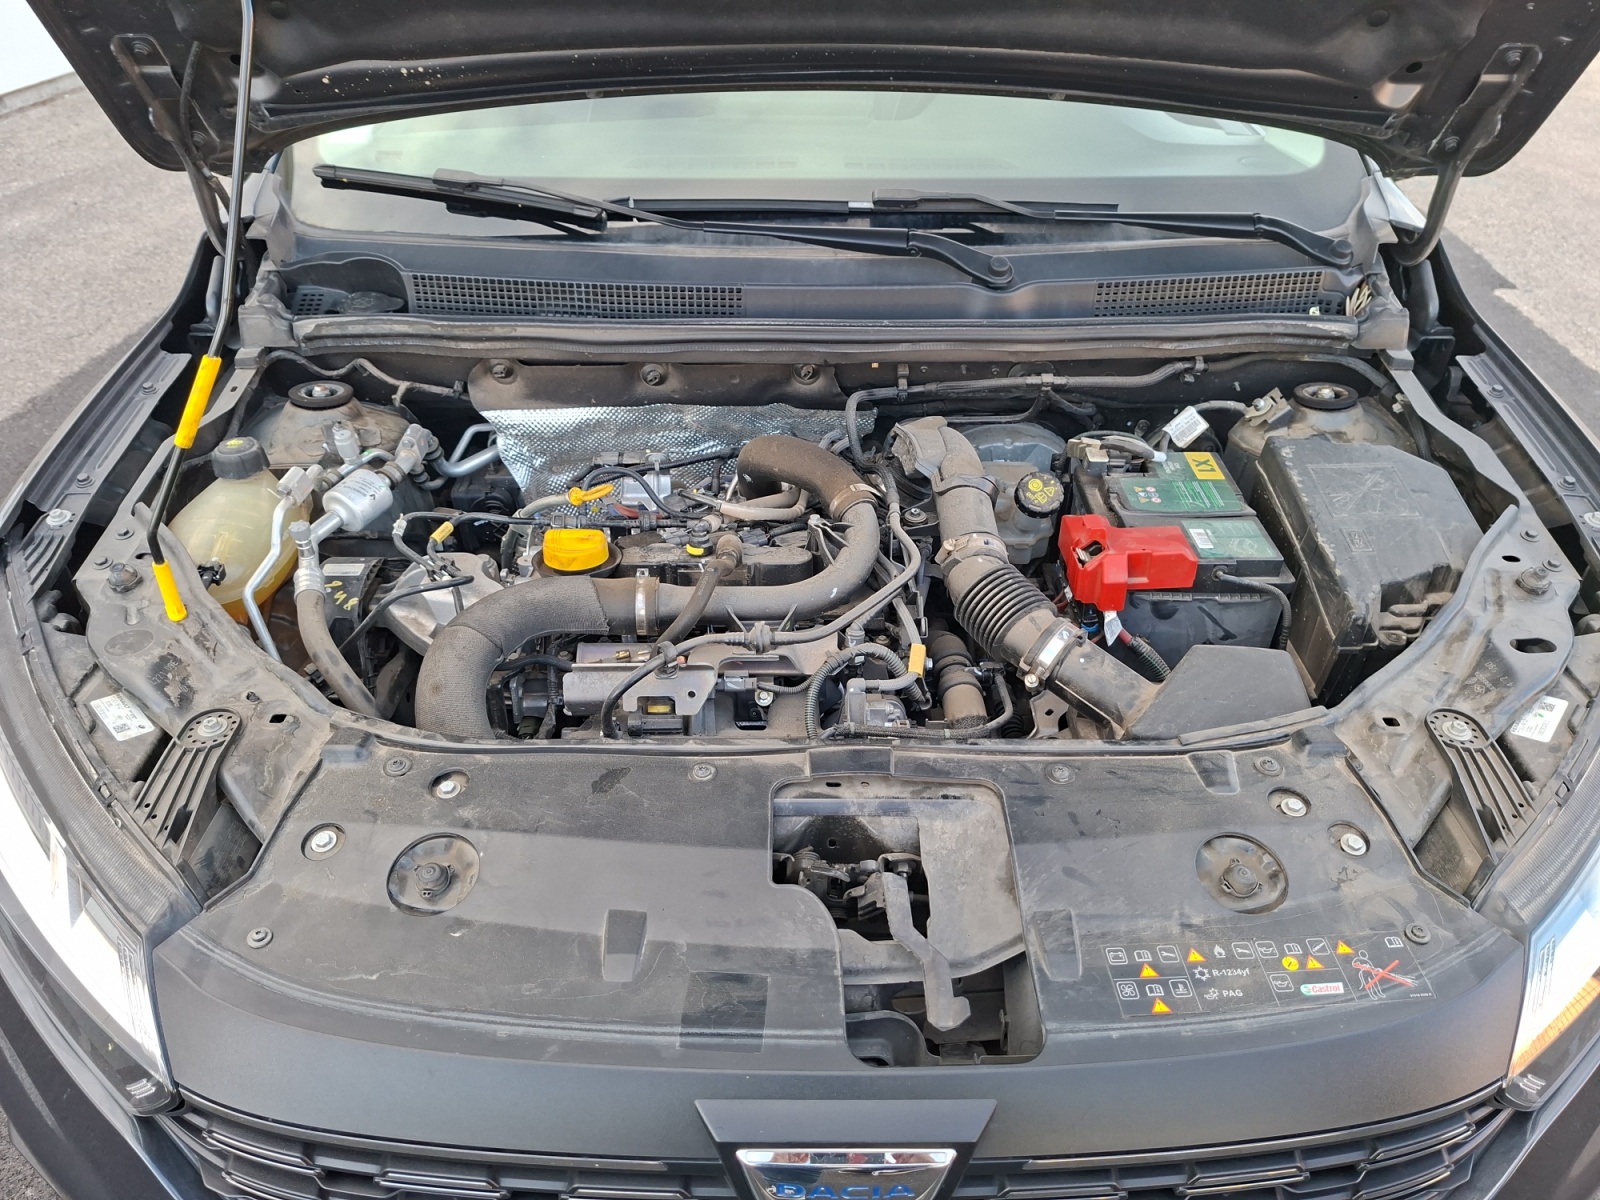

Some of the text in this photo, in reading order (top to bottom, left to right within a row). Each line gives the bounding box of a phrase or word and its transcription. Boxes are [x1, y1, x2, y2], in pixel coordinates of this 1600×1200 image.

[1212, 967, 1250, 977] R-1234yf
[1222, 989, 1243, 997] PAG
[1311, 984, 1341, 993] Castrol
[776, 1182, 916, 1200] DACIA
